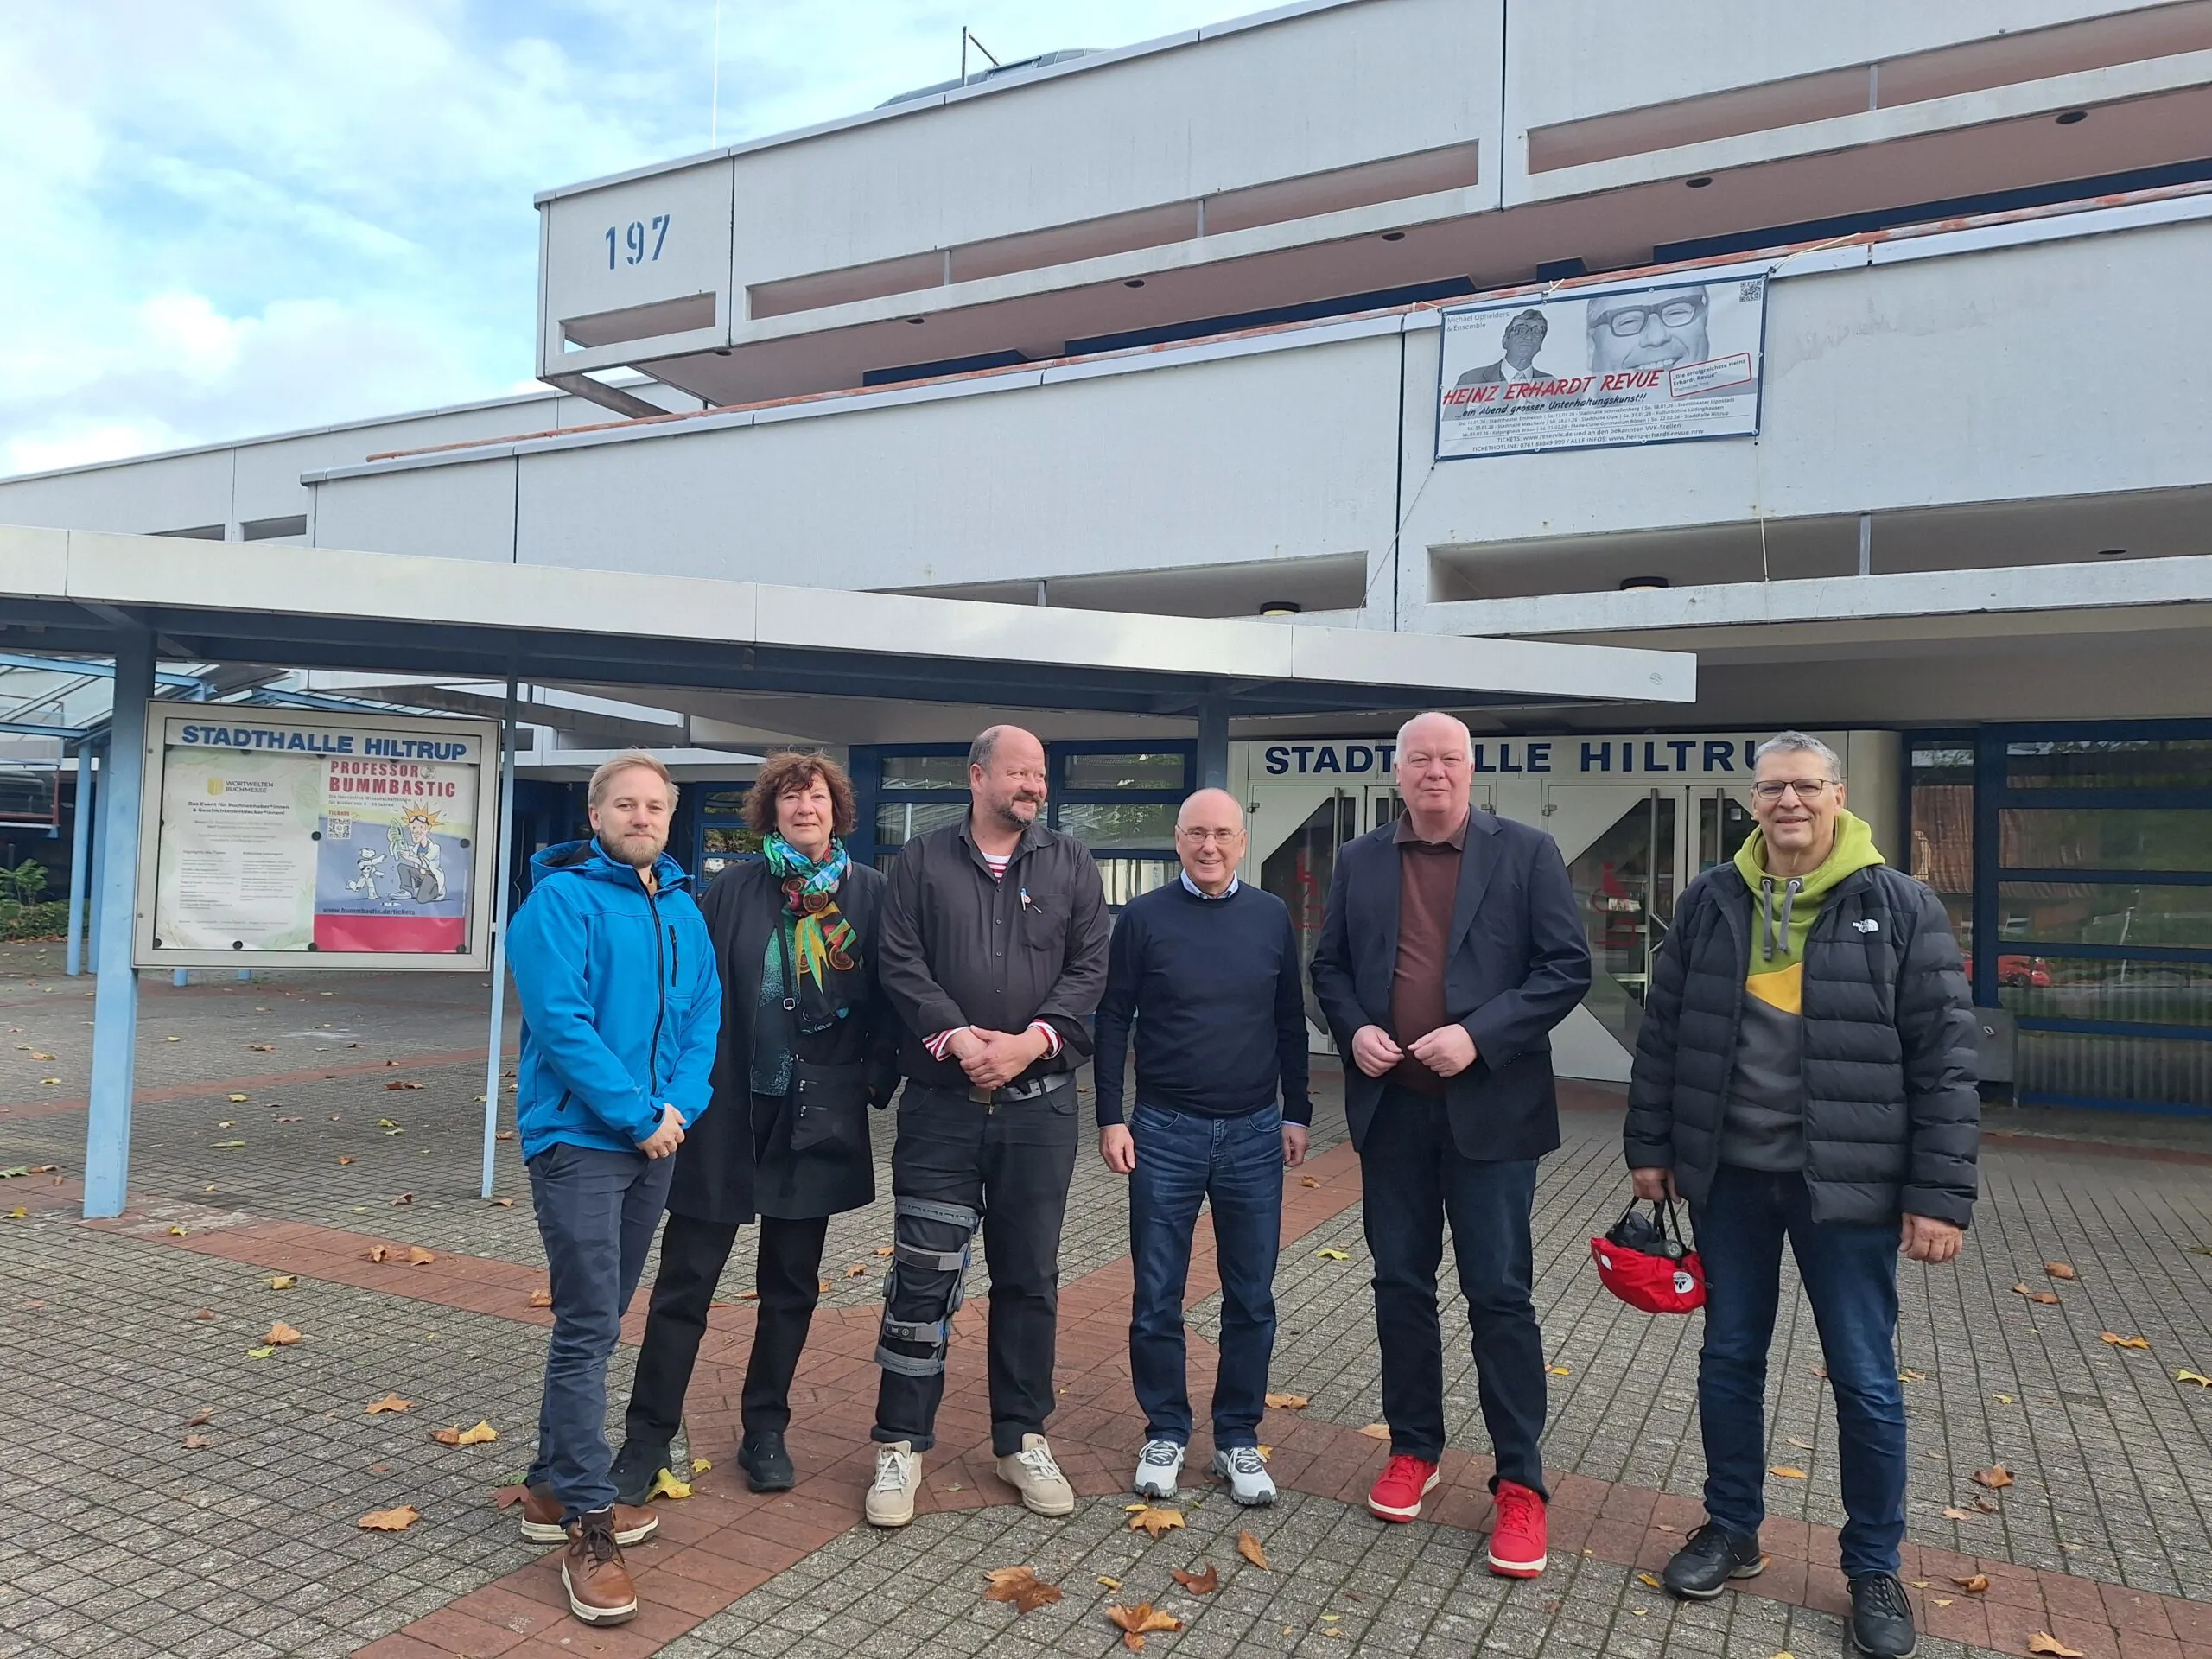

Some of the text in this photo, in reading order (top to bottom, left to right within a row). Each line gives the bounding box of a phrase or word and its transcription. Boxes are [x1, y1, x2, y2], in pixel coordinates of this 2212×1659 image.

[606, 214, 671, 270] 197
[1446, 310, 1510, 323] Michael Ophelders
[1453, 321, 1486, 331] Ensemble
[1687, 363, 1727, 376] erfolgreichste
[1442, 369, 1664, 405] HEINZ ERHARDT REVUE
[1674, 377, 1695, 386] Erhardt
[1478, 404, 1509, 416] Abend
[1510, 402, 1545, 415] grosser
[1548, 391, 1647, 411] Unterhaltungskunst!!
[1688, 404, 1724, 413] Lüdinghausen
[1570, 419, 1630, 429] Marie-Curie-Gymnasium
[1471, 443, 1519, 452] TICKETHOTLINE:
[1608, 428, 1704, 442] www.heinz-erhardt-revue.nrw
[1522, 431, 1572, 441] www.reservix.de
[181, 725, 467, 760] STADTHALLE HILTRUP
[1265, 740, 1756, 774] STADTLLE HILTR
[329, 760, 419, 777] PROFESSOR
[328, 776, 456, 797] BUMMBASTIC
